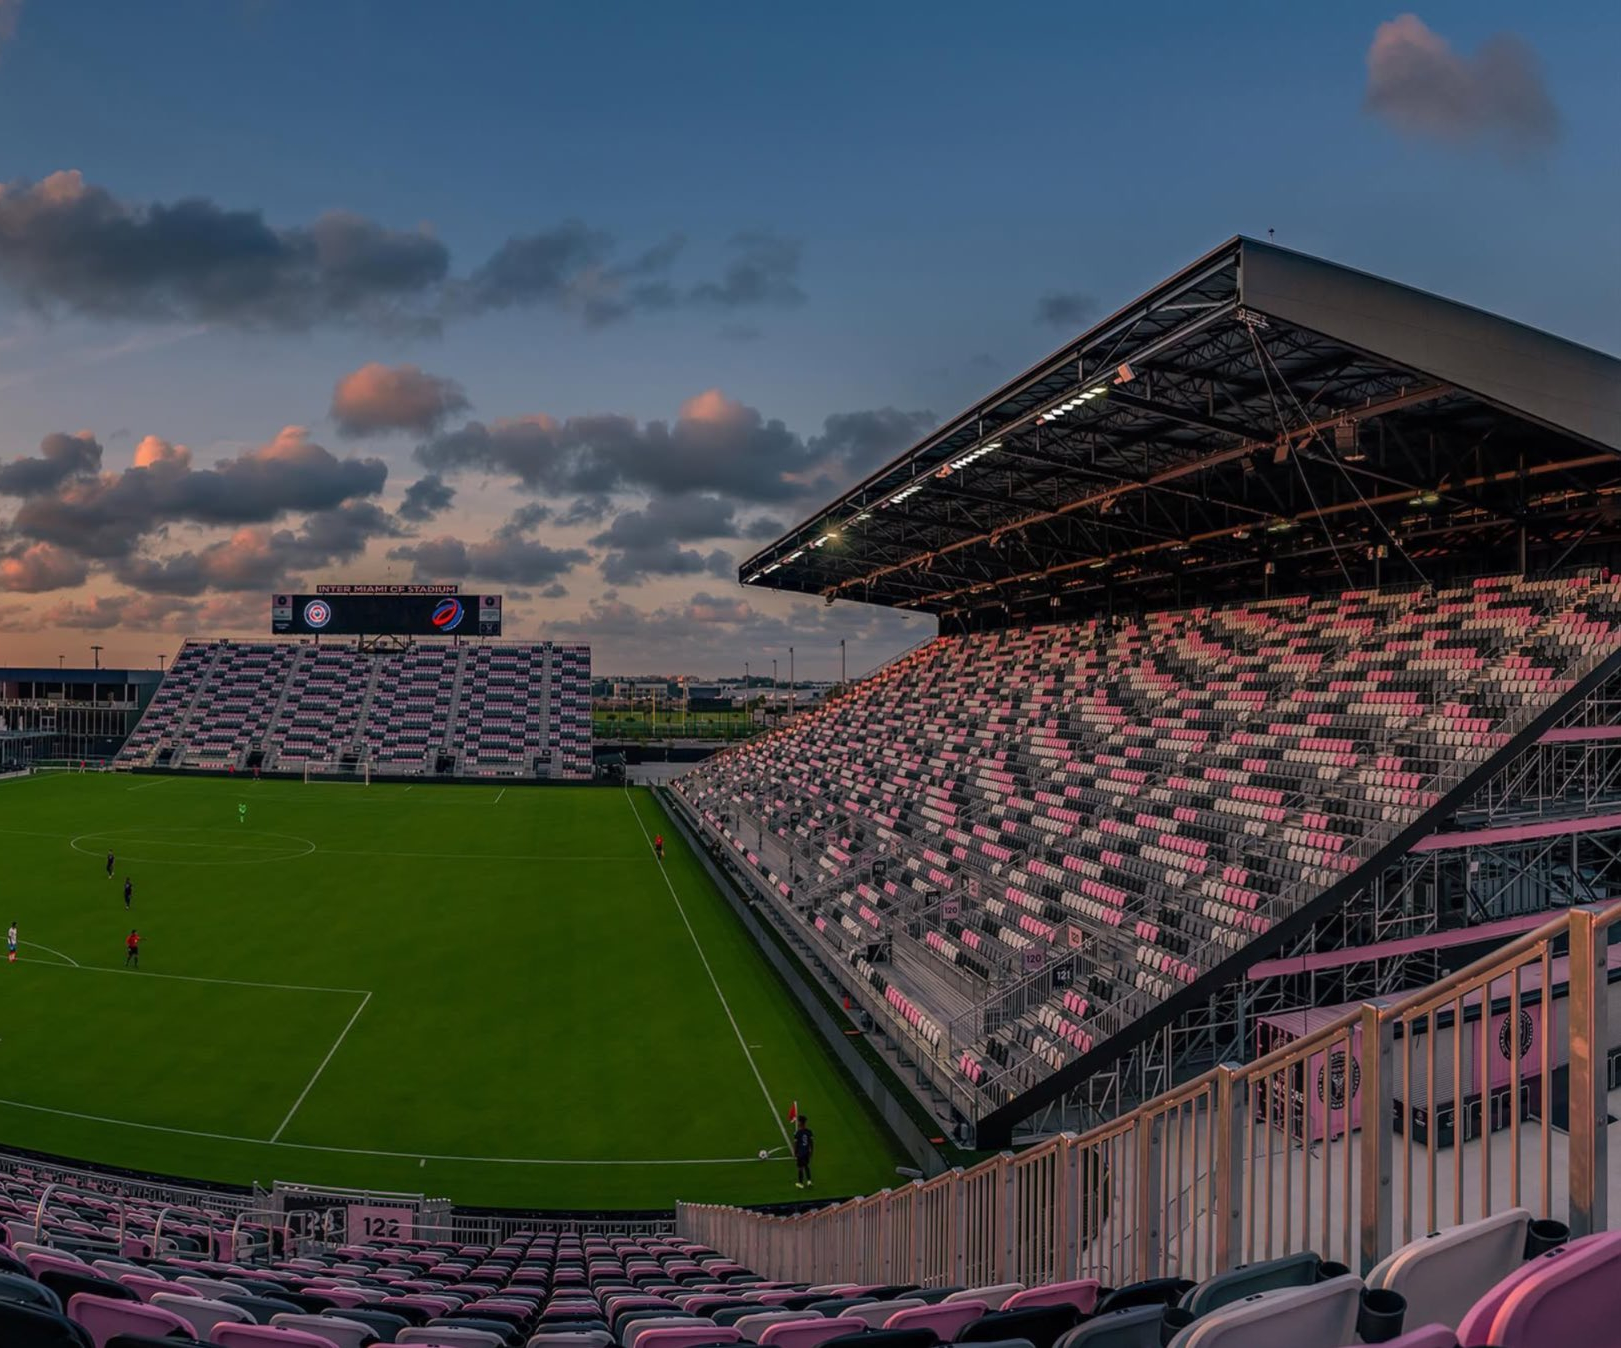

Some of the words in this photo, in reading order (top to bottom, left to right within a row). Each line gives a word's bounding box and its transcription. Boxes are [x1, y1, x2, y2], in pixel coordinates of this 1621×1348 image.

[318, 585, 351, 593] INTER
[353, 585, 388, 593] MIAMI
[408, 585, 456, 593] STADIUM
[945, 906, 958, 914] 120
[1026, 953, 1042, 963] 120
[1056, 970, 1071, 980] 121
[363, 1217, 400, 1238] 122
